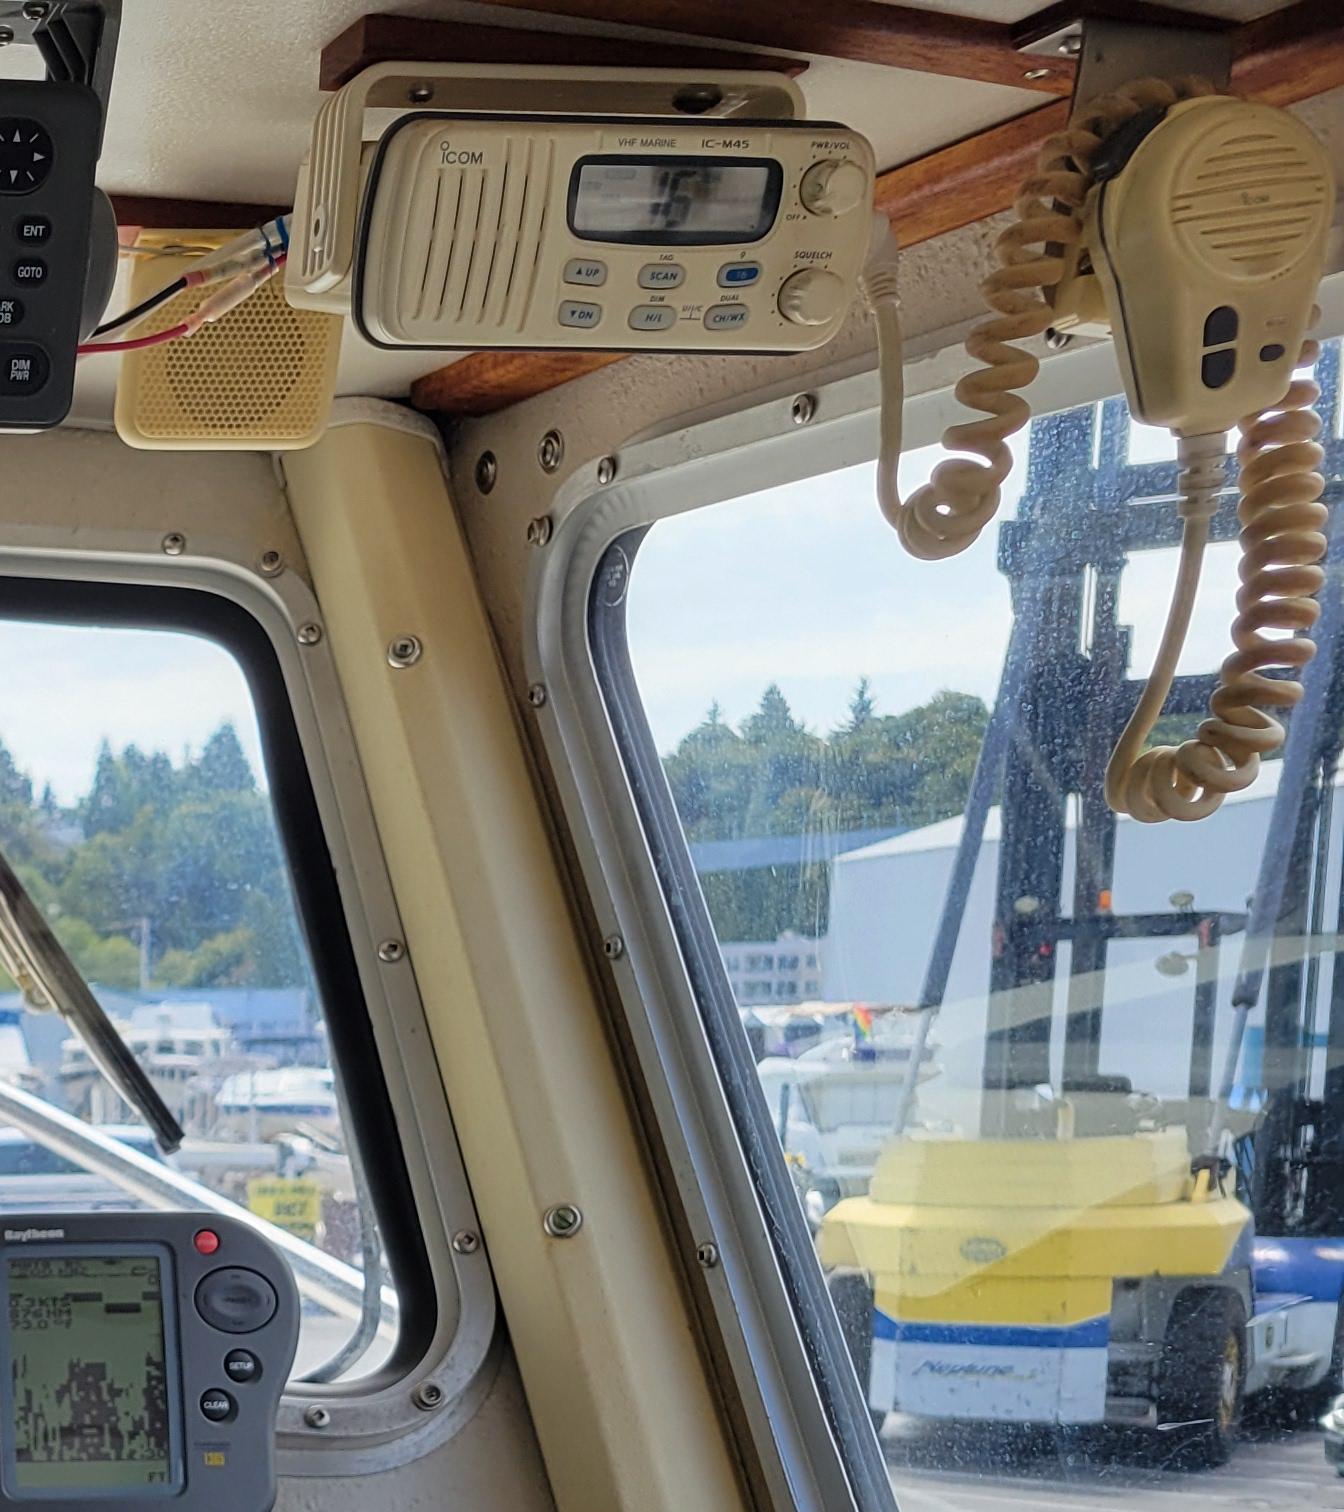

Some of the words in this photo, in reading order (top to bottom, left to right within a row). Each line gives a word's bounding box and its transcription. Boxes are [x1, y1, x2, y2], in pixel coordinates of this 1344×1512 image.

[618, 138, 637, 147] VHF
[640, 138, 676, 148] MARINE
[701, 139, 750, 149] IC-M45
[23, 225, 46, 237] ENT
[17, 266, 43, 278] GOTO
[650, 272, 678, 281] SCAN
[12, 359, 31, 371] DIM
[10, 370, 30, 381] PWR
